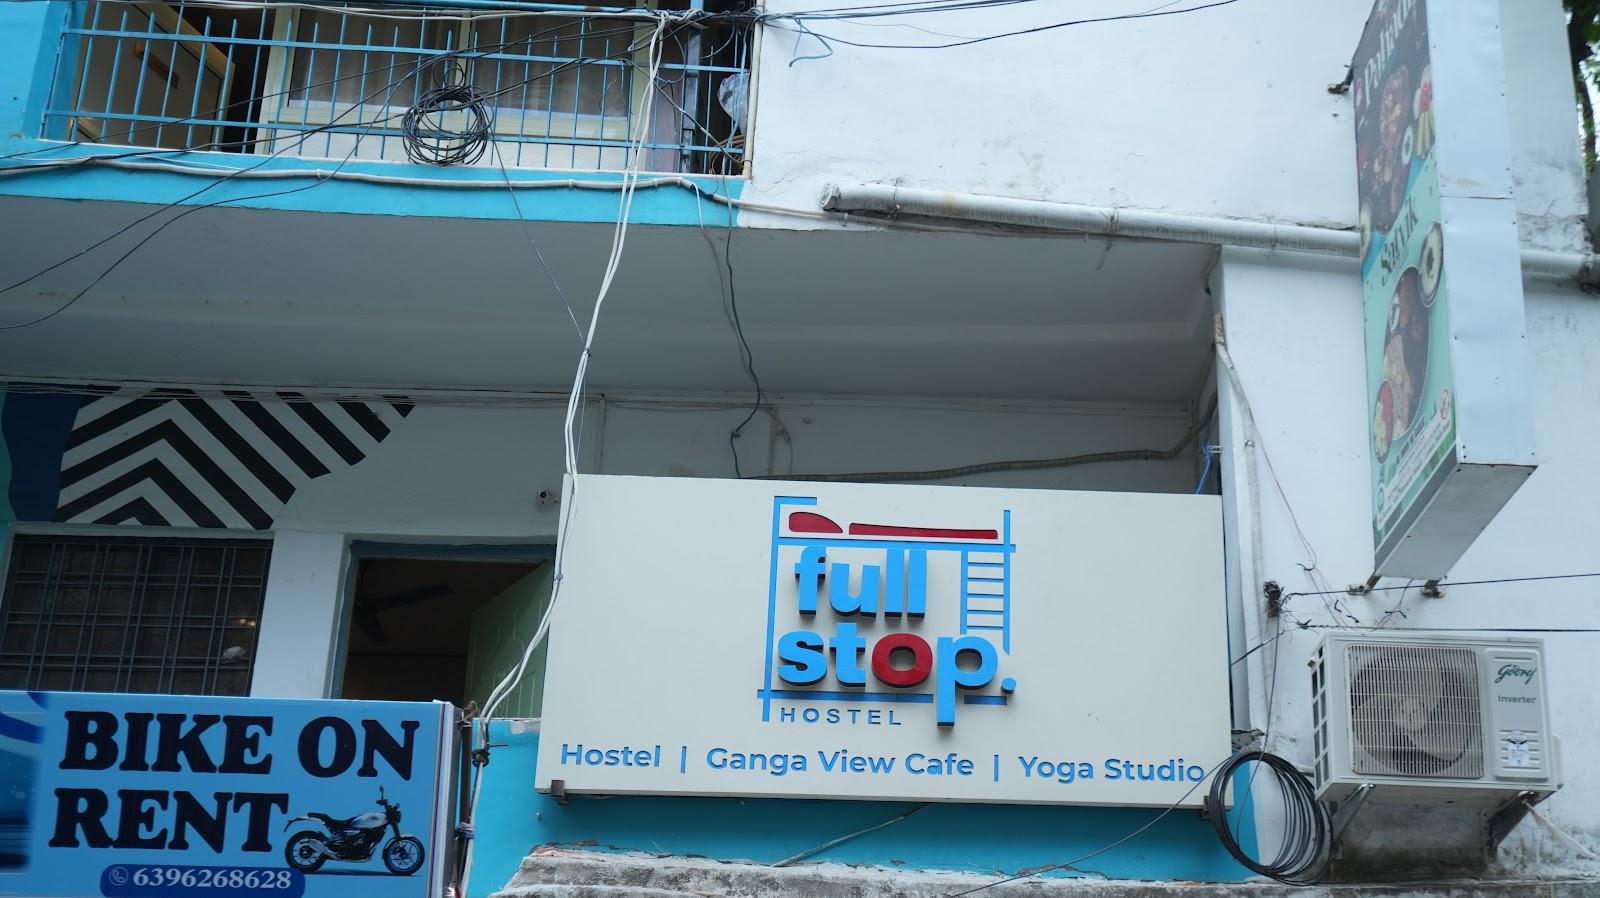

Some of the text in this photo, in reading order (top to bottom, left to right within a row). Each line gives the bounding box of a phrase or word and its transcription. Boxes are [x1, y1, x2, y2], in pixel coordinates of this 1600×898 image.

[1364, 0, 1412, 108] Pahad
[1381, 195, 1418, 287] Satvik
[794, 545, 928, 617] full
[1494, 664, 1538, 685] Godrej
[1498, 694, 1537, 705] Inverter
[780, 706, 902, 726] HOSTEL
[58, 710, 420, 781] BIKE ON
[560, 743, 661, 768] Hostel
[706, 747, 808, 777] Ganga
[817, 749, 896, 774] View
[904, 752, 975, 776] Cafe
[1017, 755, 1095, 785] Yoga
[1103, 757, 1206, 783] Studio
[48, 787, 290, 854] RENT
[132, 867, 292, 890] 6396268628
